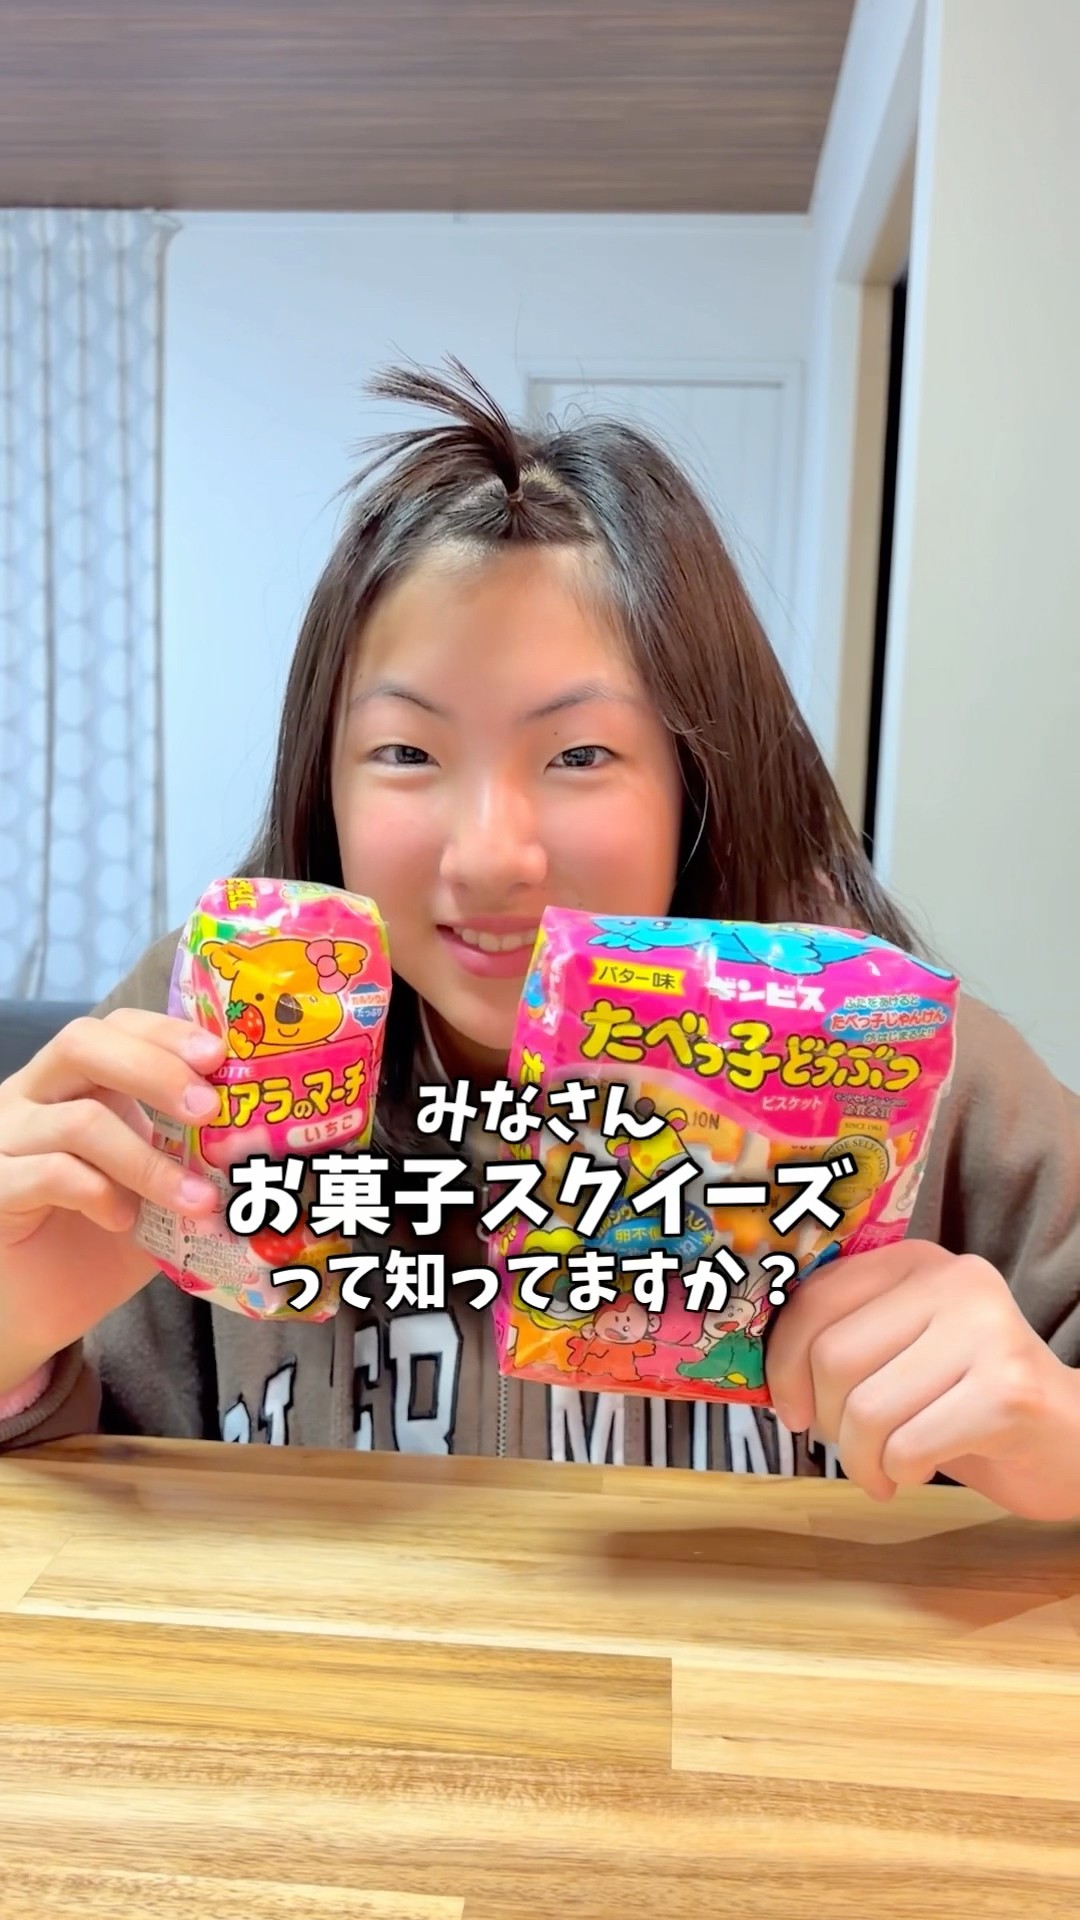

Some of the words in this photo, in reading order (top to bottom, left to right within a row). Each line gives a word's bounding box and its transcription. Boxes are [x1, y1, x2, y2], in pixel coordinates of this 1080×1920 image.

[597, 965, 677, 990] バター味
[708, 977, 826, 1013] ギンビス
[831, 1008, 947, 1031] たべっ子じゃんけん
[581, 999, 922, 1092] たべっ子どうぶつ
[762, 1095, 823, 1112] ビスケット
